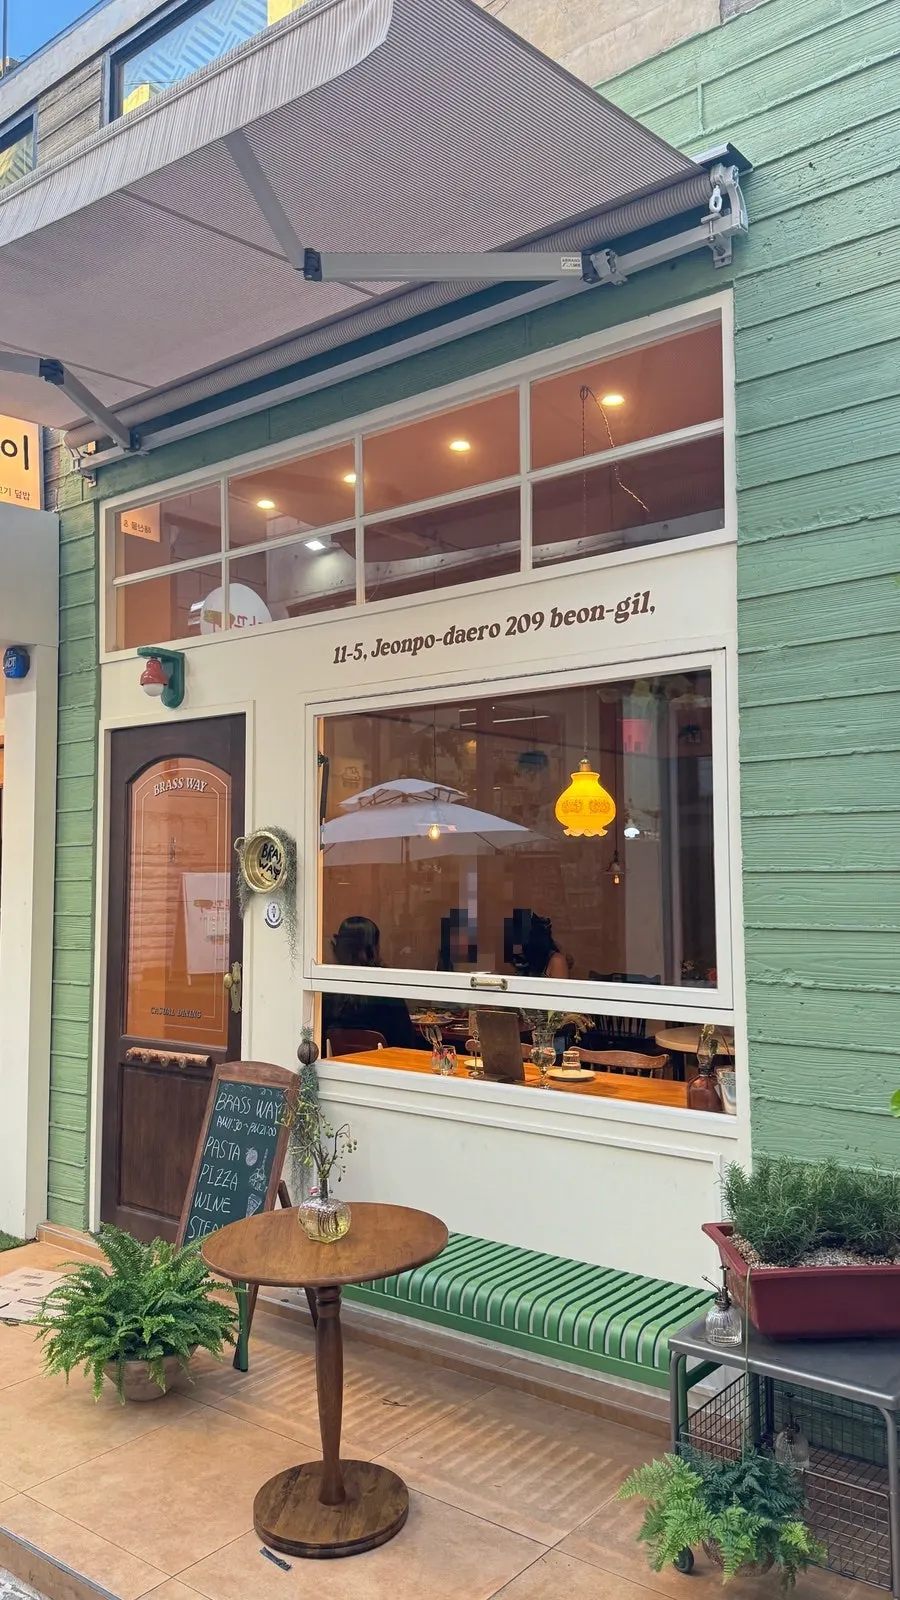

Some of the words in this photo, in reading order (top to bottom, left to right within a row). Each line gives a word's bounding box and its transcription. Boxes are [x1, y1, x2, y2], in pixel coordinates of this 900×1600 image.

[333, 643, 368, 664] 11-5,
[371, 622, 501, 658] Jeonpo-daero
[505, 611, 545, 636] 209
[549, 590, 656, 628] beon-gil,
[153, 777, 184, 796] BRASS
[186, 777, 208, 793] WAY
[151, 1007, 175, 1017] CASUAL
[177, 1008, 202, 1019] DINING
[215, 1092, 251, 1115] BRASS
[256, 1099, 282, 1121] WAY
[204, 1136, 241, 1161] PASTA
[199, 1163, 238, 1191] PIZZA
[194, 1191, 231, 1213] WINE
[187, 1215, 224, 1239] STEA
